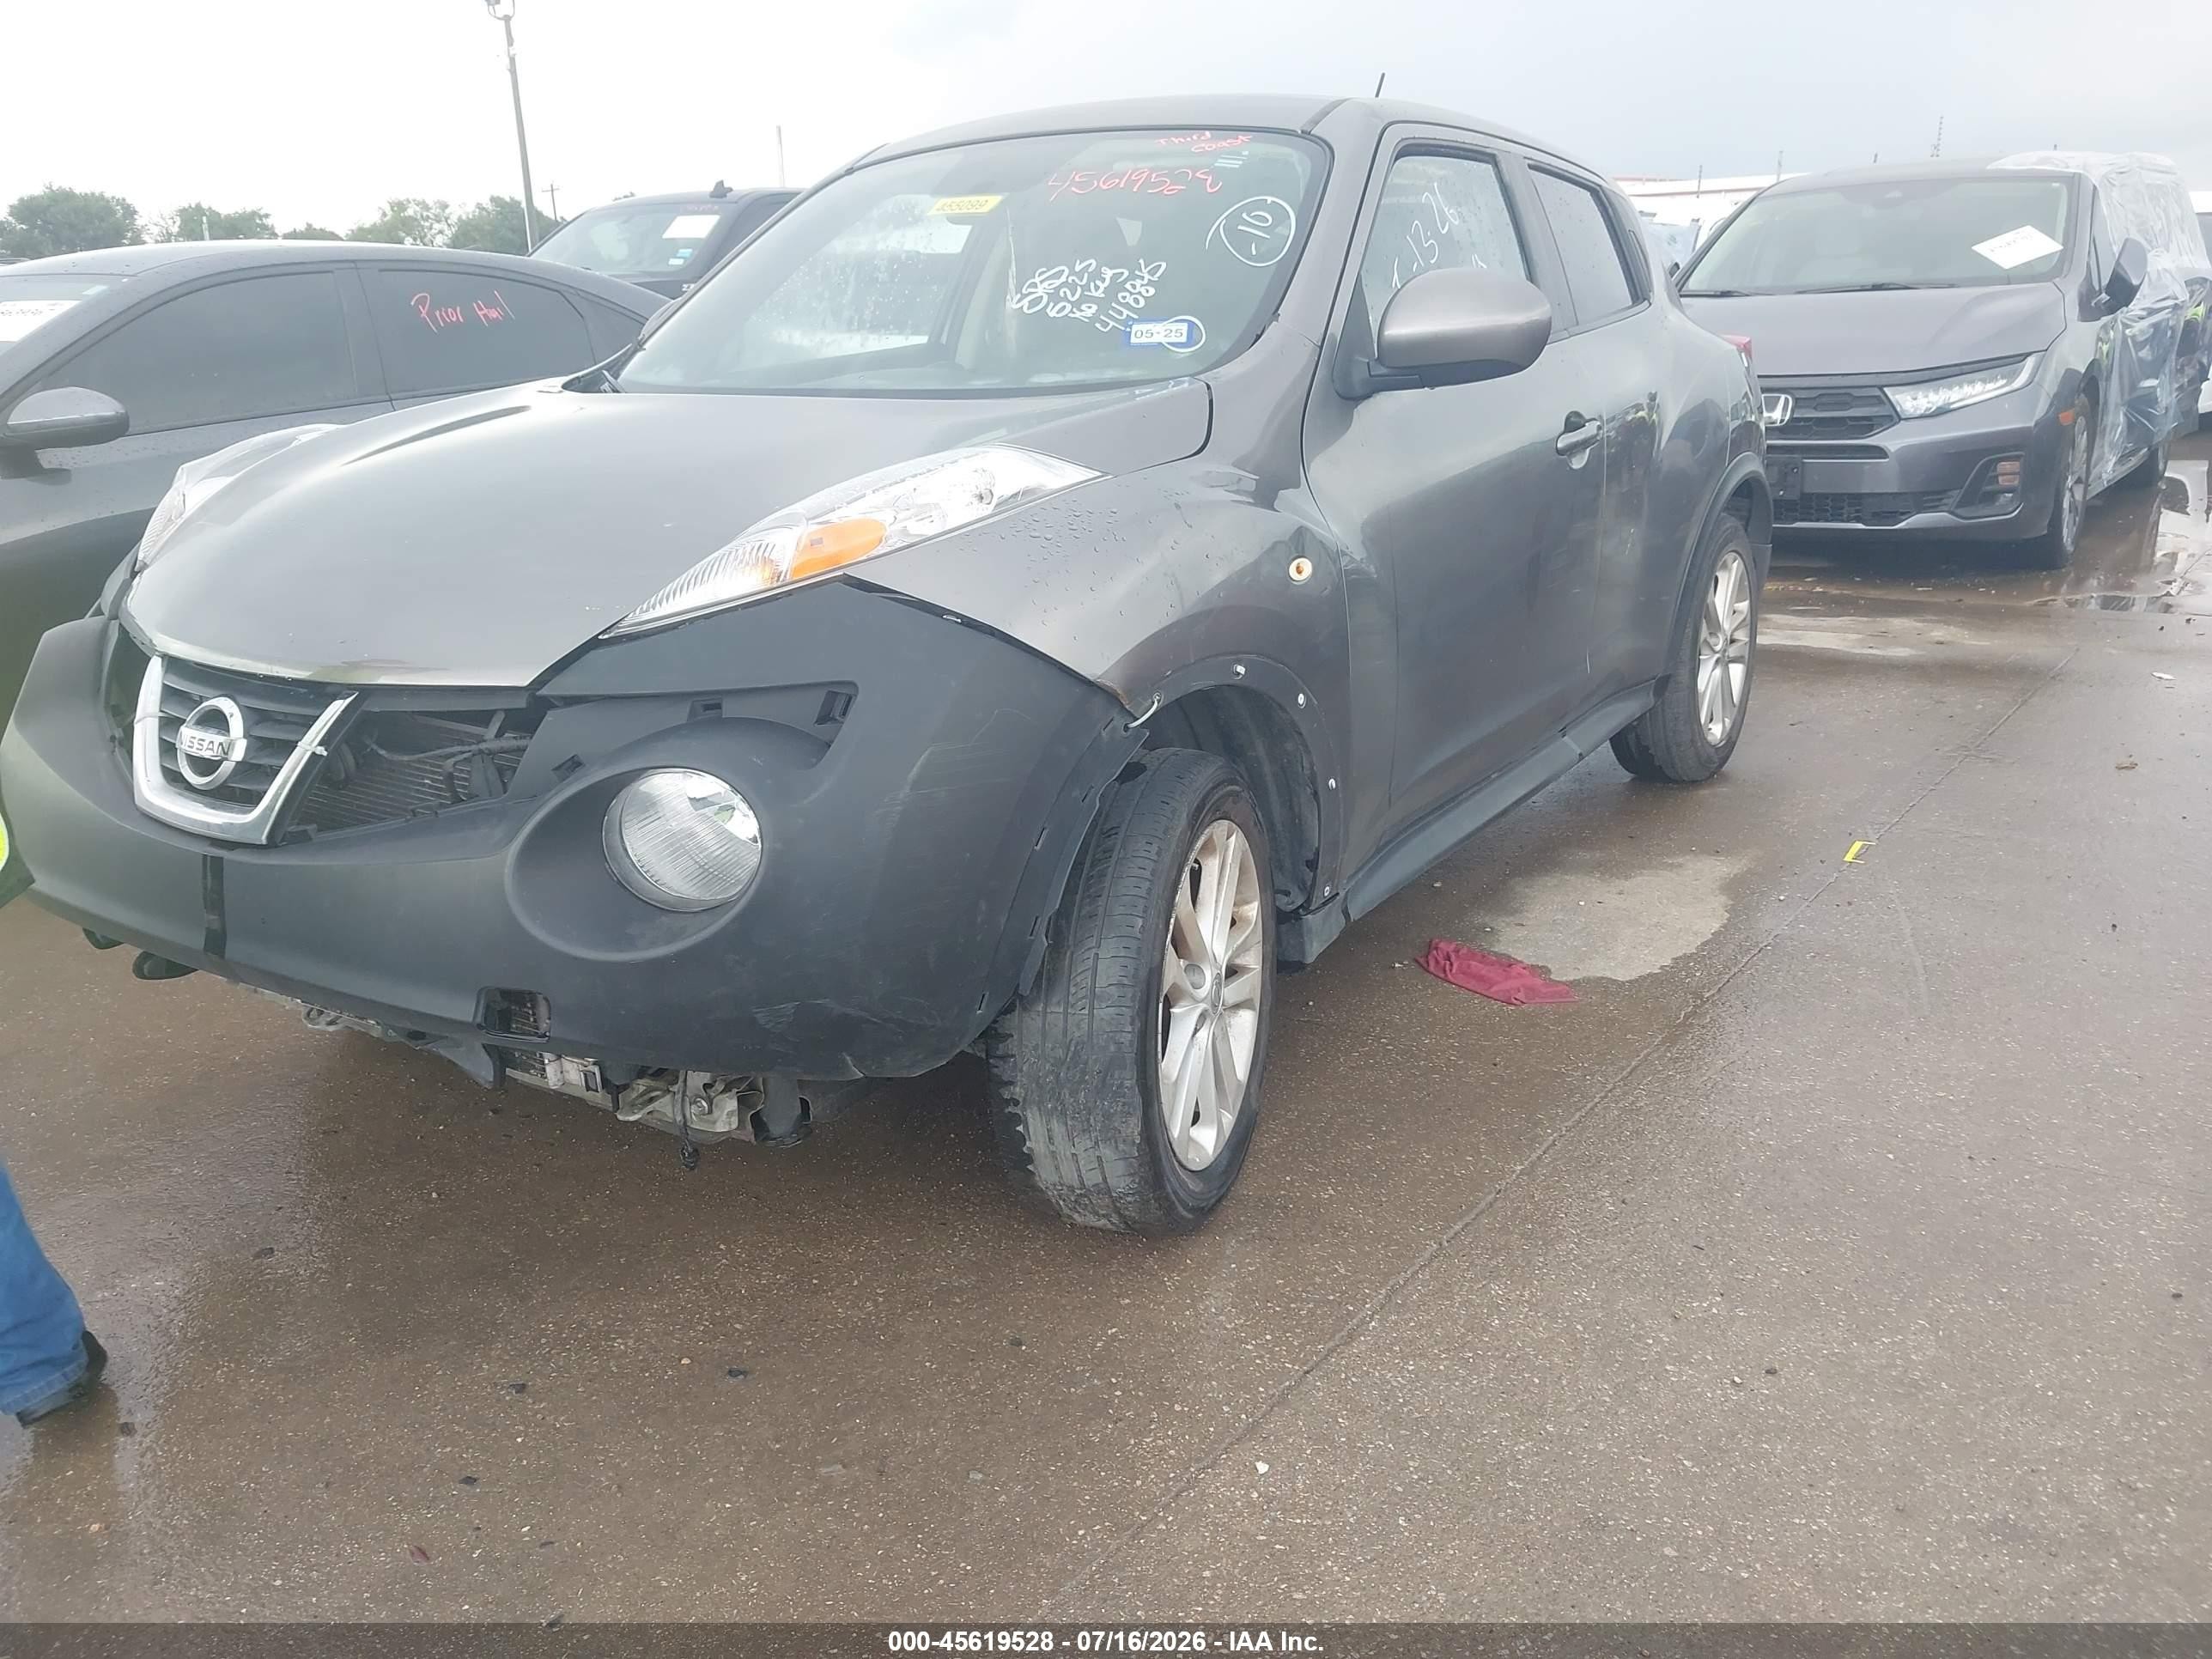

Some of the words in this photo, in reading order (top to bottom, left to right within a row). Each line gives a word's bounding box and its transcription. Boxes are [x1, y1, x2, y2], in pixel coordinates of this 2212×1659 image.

[1191, 135, 1253, 153] Coast
[1048, 167, 1223, 203] 45619528
[410, 292, 465, 333] Prior
[1133, 327, 1184, 340] 05-25
[179, 730, 232, 757] NISSAN
